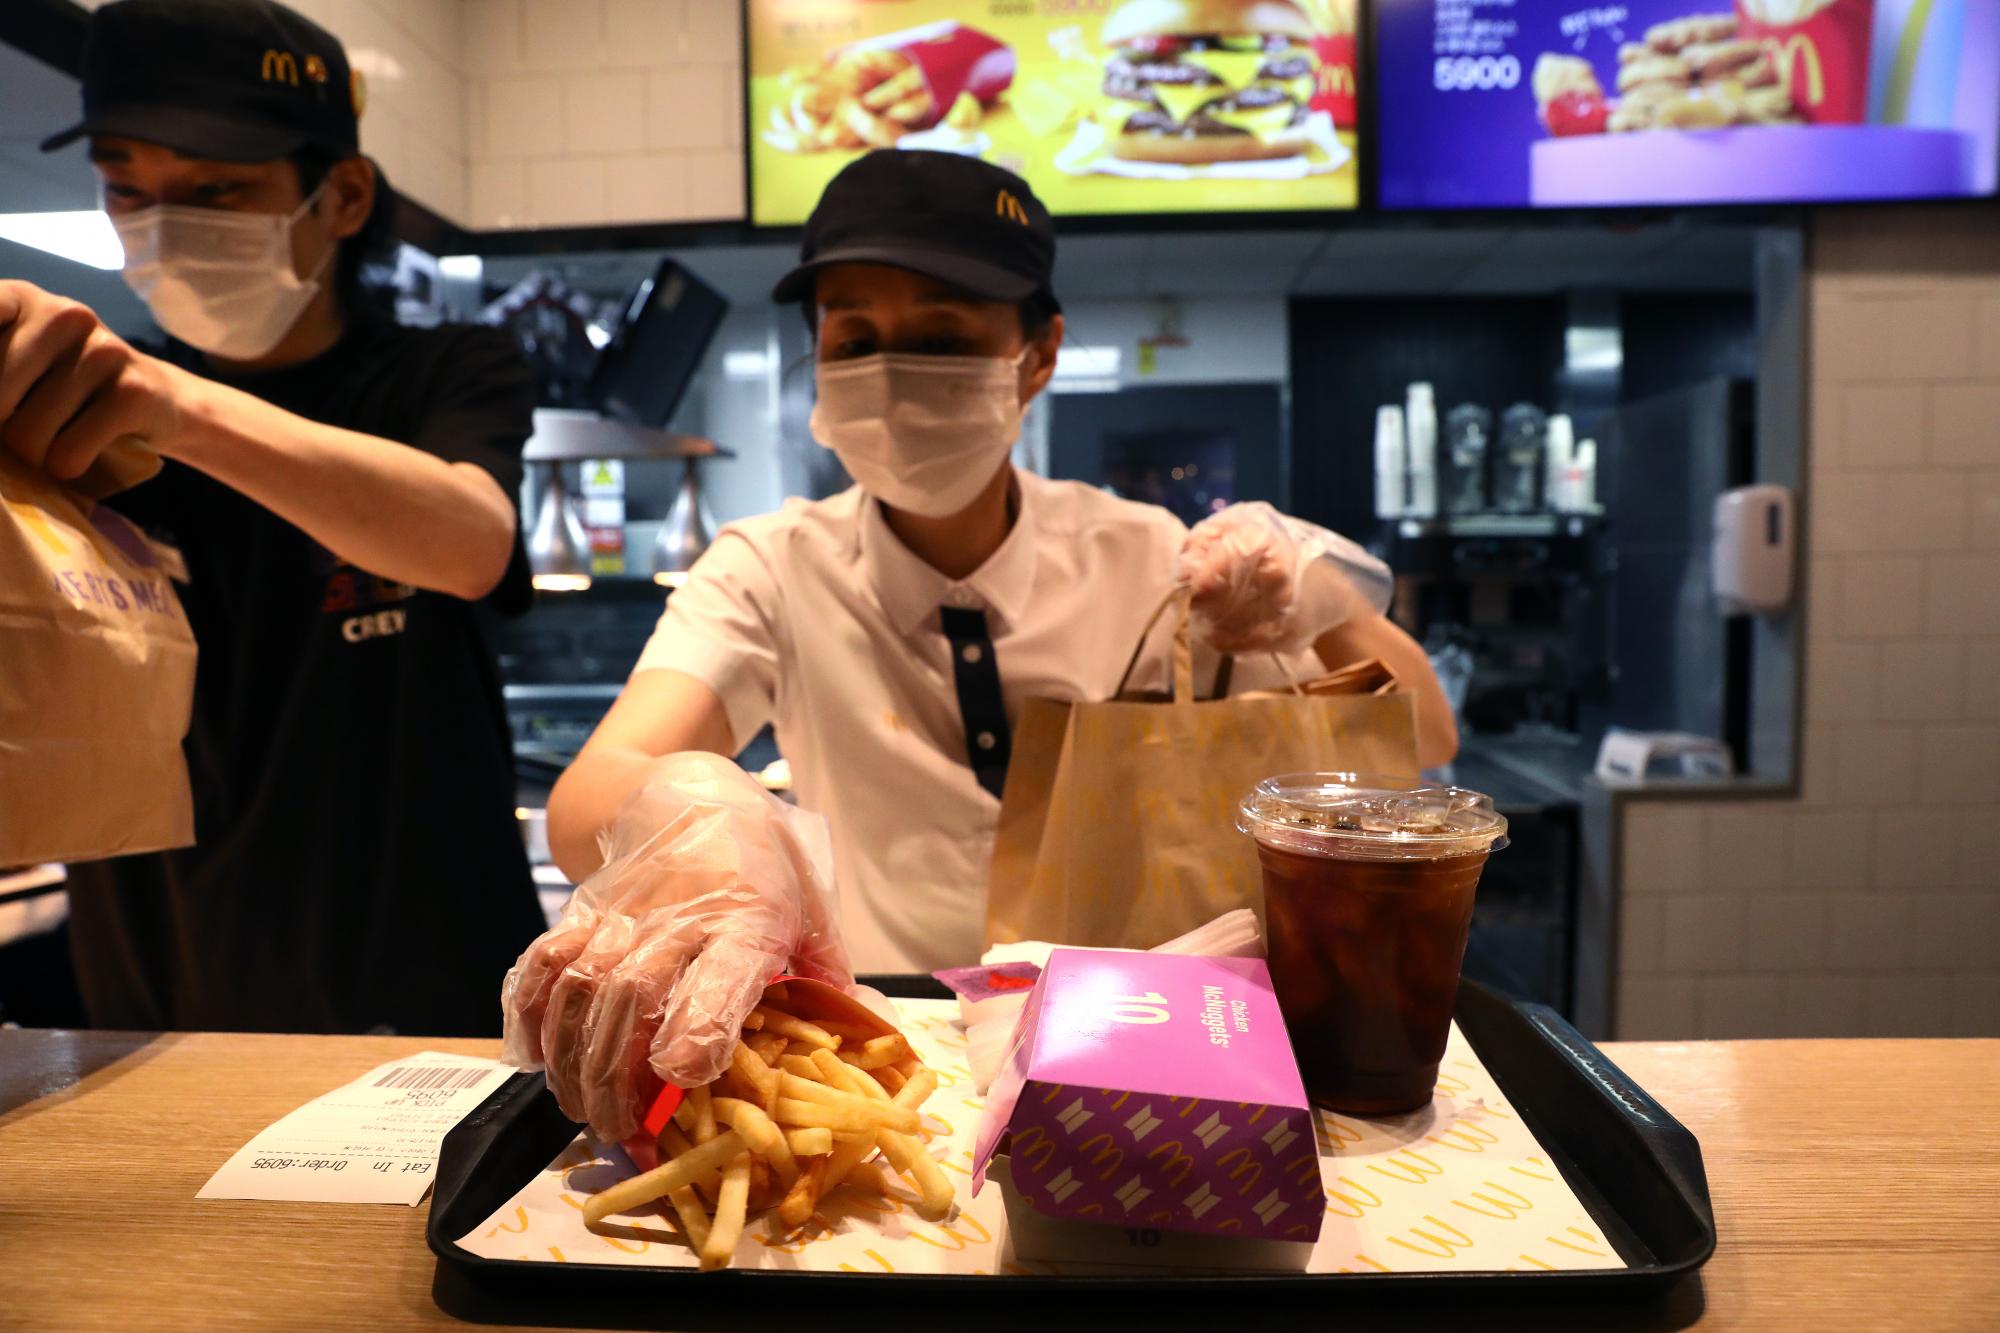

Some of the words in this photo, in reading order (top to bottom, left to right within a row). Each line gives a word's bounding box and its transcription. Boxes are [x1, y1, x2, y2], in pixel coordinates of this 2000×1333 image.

[1433, 55, 1521, 91] 5900
[1103, 991, 1171, 1025] 10
[1230, 1000, 1250, 1032] Chicken
[250, 1157, 349, 1172] Order:6095
[372, 1161, 395, 1173] In
[401, 1163, 432, 1174] Eat
[1123, 1227, 1161, 1248] 10
